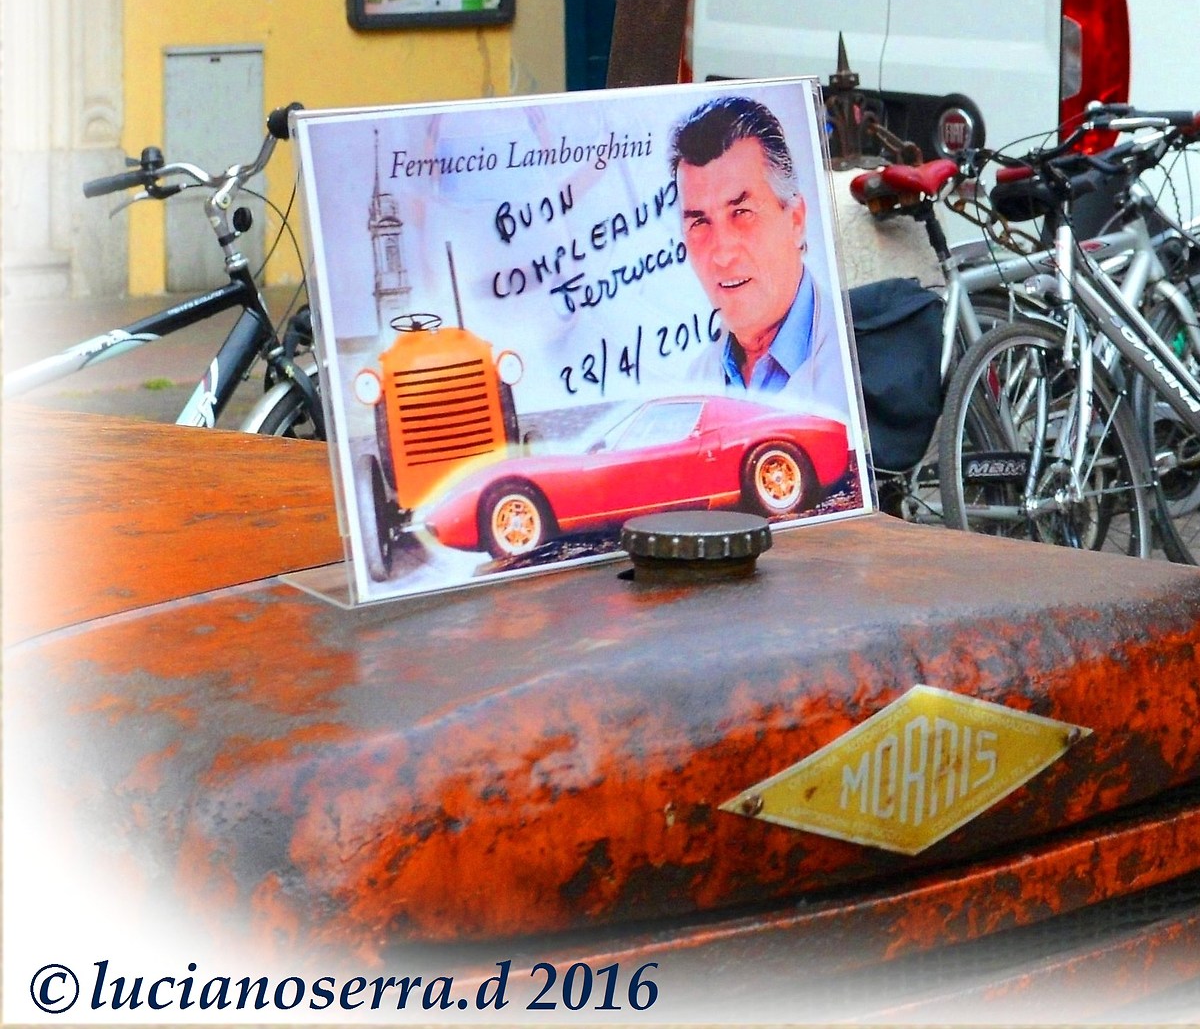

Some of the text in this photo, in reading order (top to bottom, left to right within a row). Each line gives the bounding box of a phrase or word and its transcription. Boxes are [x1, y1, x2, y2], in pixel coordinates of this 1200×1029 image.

[389, 131, 653, 179] Ferruccio Lamborghini
[943, 122, 965, 144] FIAT
[495, 184, 574, 244] BUON
[550, 237, 688, 313] Ferruccio
[967, 459, 1028, 477] MBM
[840, 714, 999, 828] MORRIS
